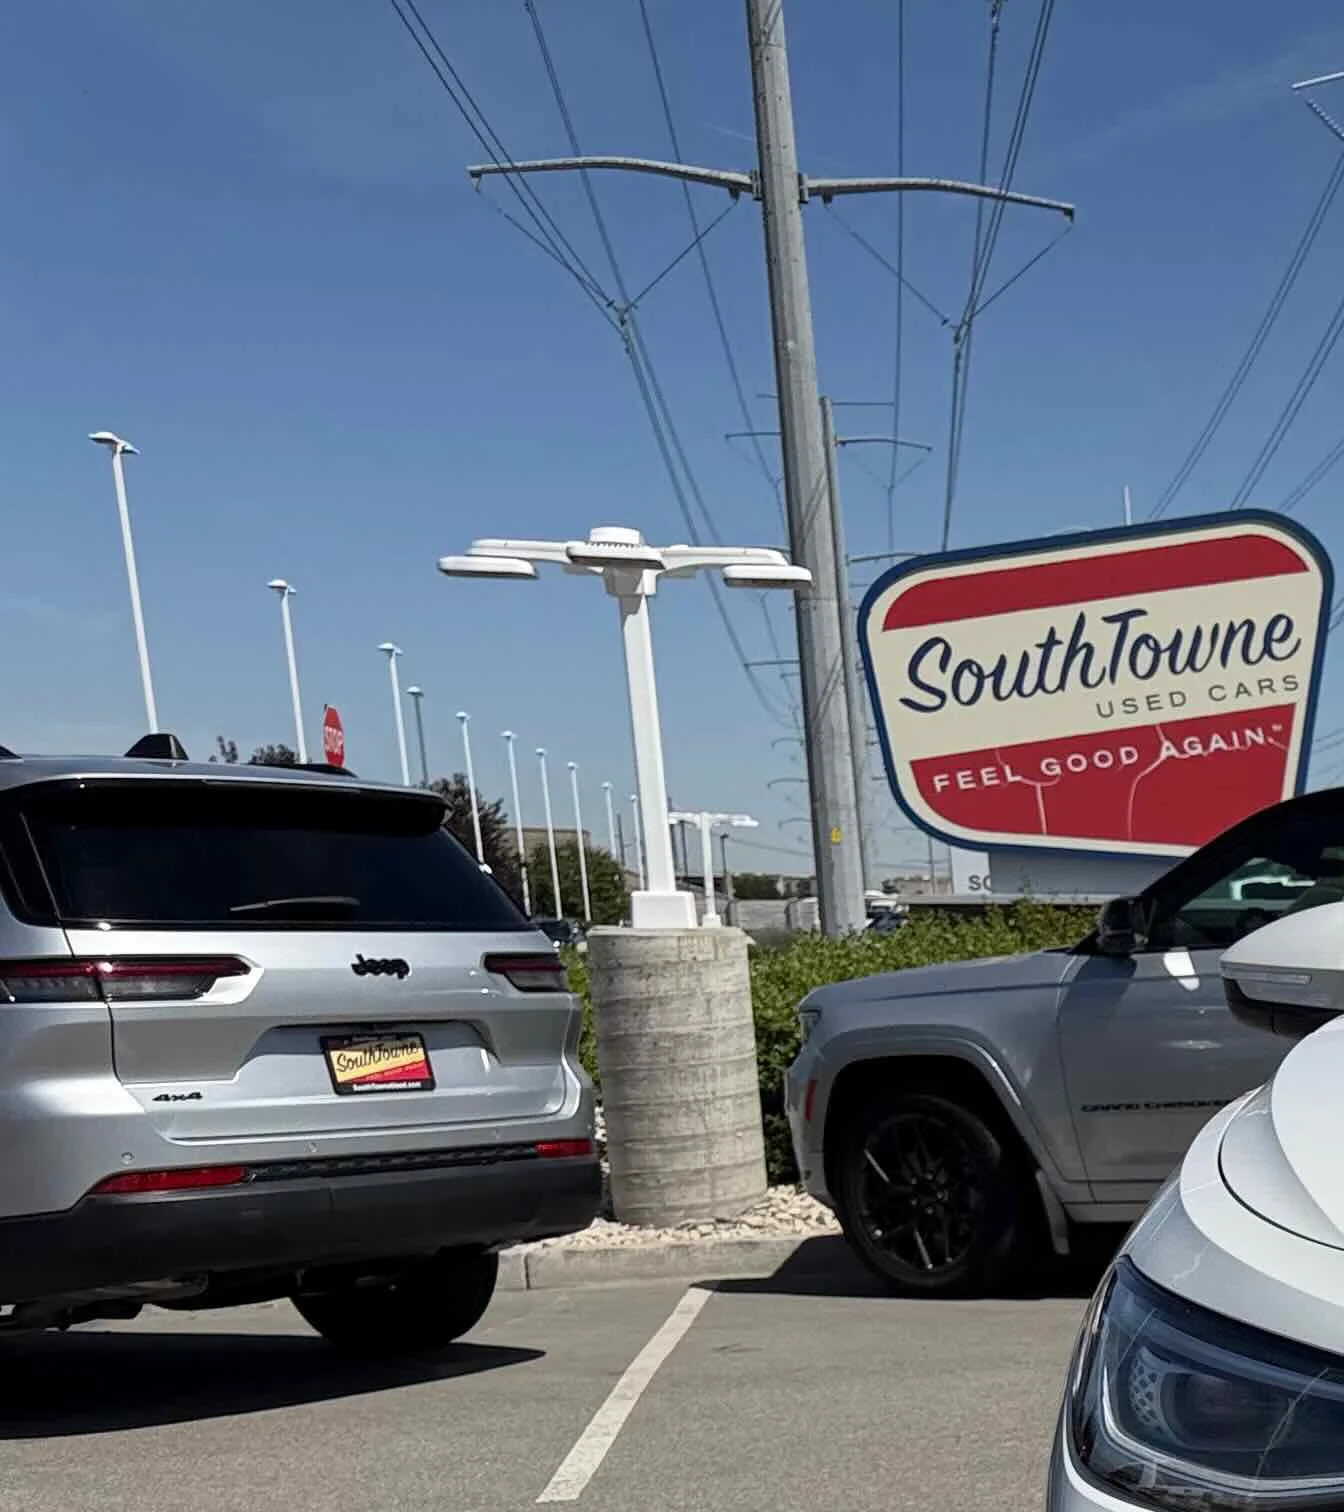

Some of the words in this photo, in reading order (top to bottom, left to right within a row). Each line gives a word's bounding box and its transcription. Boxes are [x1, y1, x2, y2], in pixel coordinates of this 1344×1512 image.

[900, 609, 1301, 713] SouthTowne
[1096, 691, 1187, 718] USED
[1208, 675, 1299, 702] CARS
[933, 764, 1022, 793] FEEL
[1040, 746, 1139, 776] GOOD
[351, 953, 410, 980] Jeep
